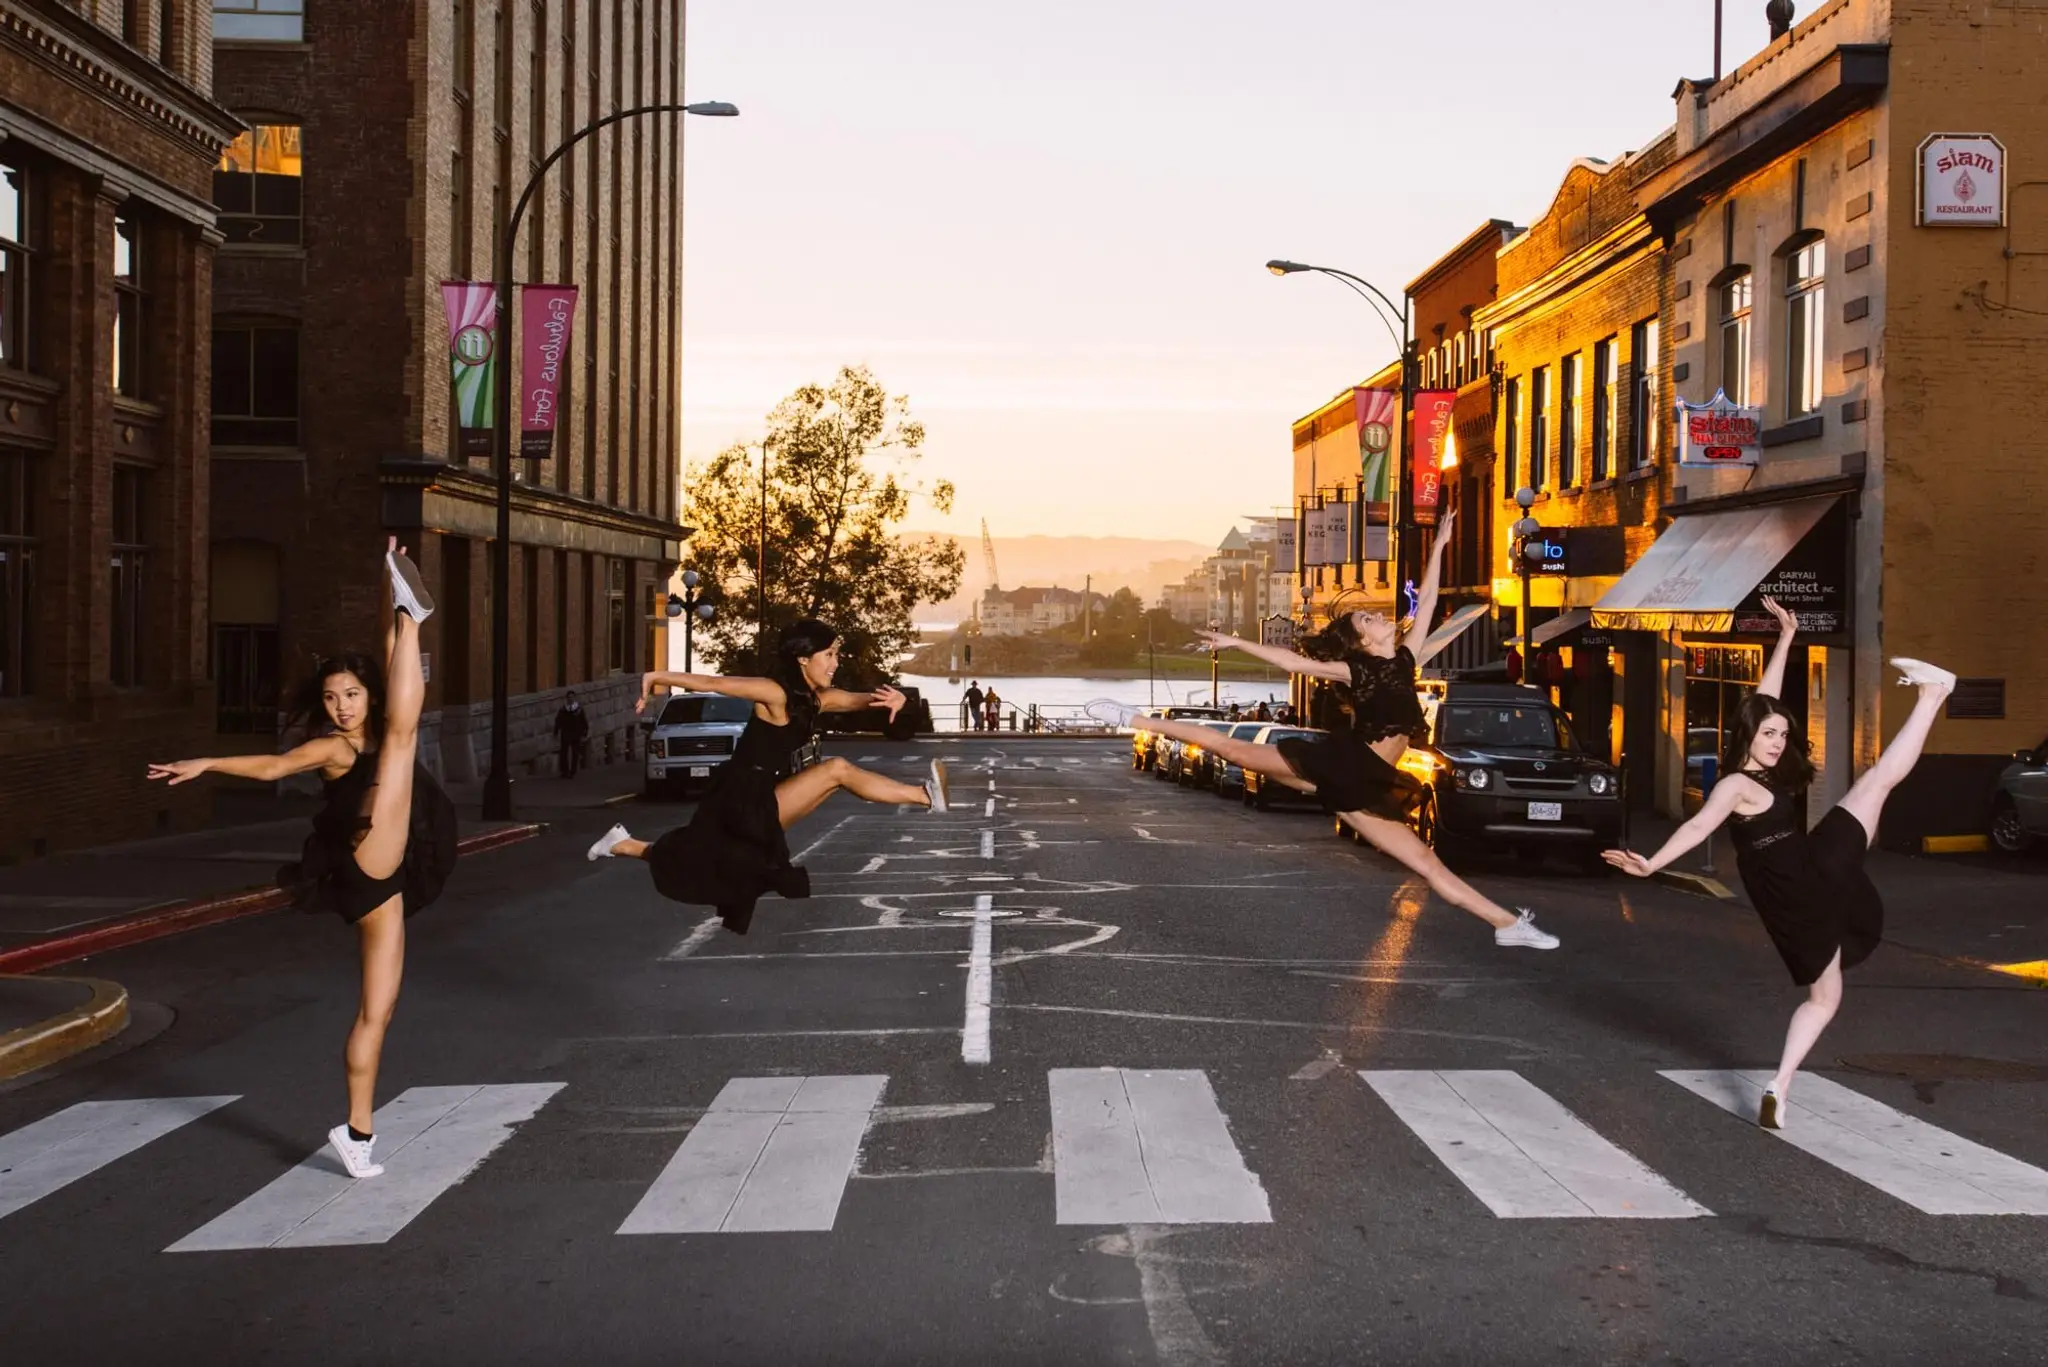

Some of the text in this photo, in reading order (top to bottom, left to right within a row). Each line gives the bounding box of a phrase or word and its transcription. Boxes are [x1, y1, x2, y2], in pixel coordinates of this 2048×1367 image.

[1936, 147, 1994, 173] siam
[1936, 205, 1993, 214] RESTAURANT
[1759, 580, 1819, 593] architect
[1785, 594, 1799, 602] Fort
[1802, 594, 1824, 602] Street
[1267, 637, 1289, 645] KEG
[1582, 635, 1611, 645] sushi
